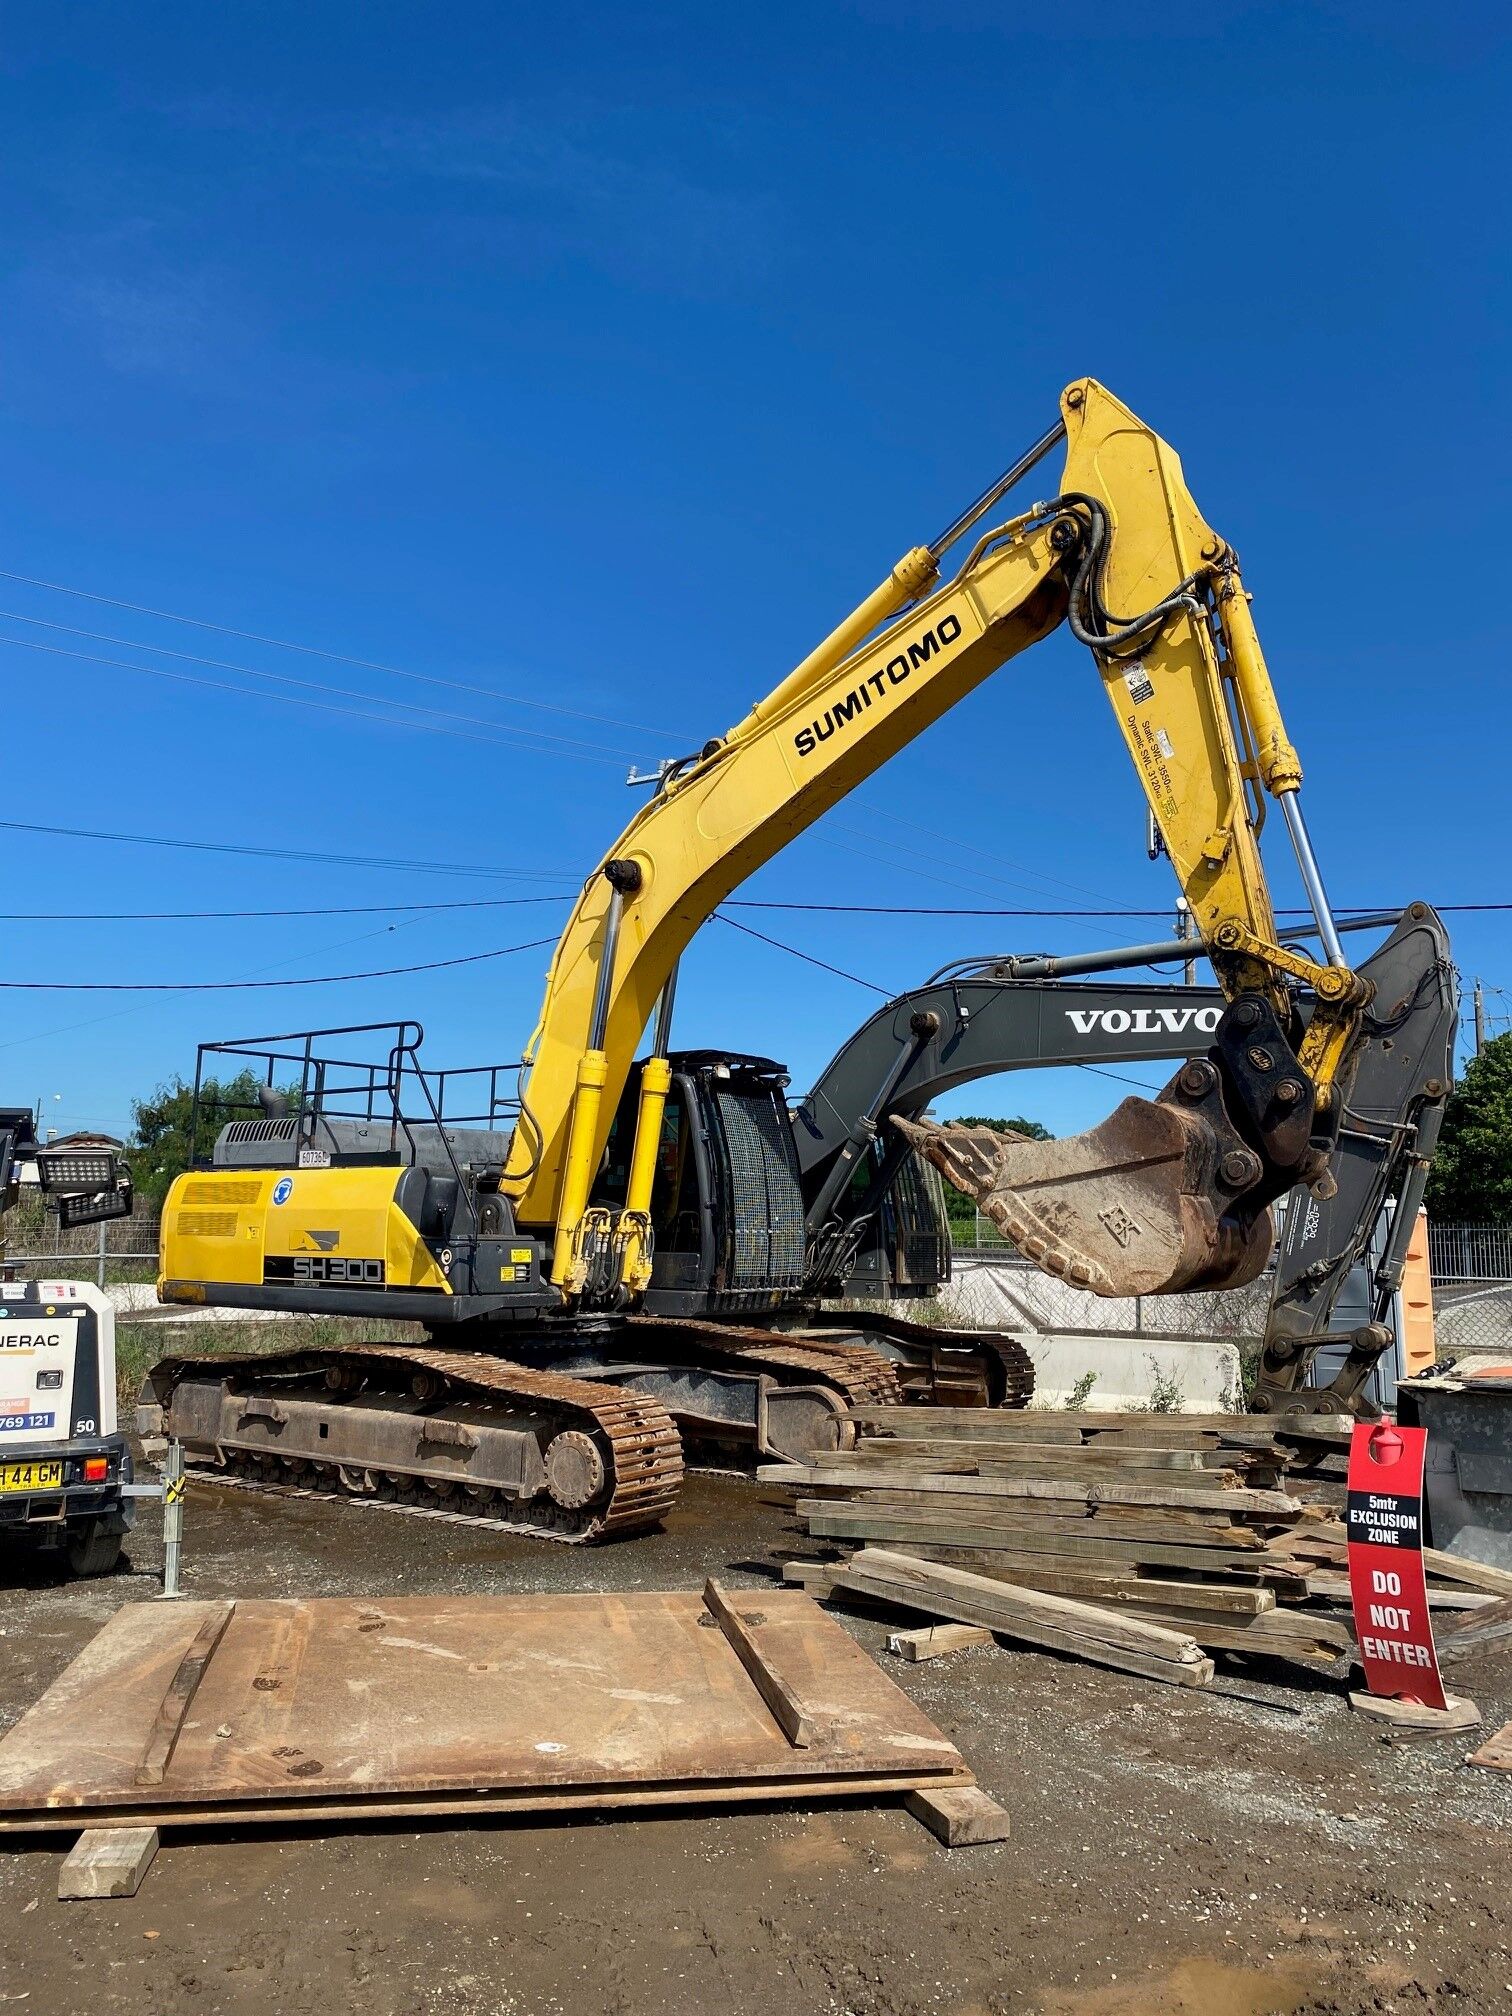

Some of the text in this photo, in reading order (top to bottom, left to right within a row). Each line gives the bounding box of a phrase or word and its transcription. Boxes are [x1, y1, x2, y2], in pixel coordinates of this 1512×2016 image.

[794, 614, 962, 757] SUMITOMO
[1127, 714, 1144, 749] Dynamic
[1140, 749, 1152, 771] SWL:
[1142, 720, 1155, 744] Static
[1150, 743, 1163, 765] SWL:
[1065, 1007, 1224, 1034] VOLVO
[28, 1414, 49, 1427] 121
[76, 1419, 95, 1433] 50
[12, 1466, 32, 1485] 44
[38, 1463, 60, 1483] GM
[1369, 1495, 1398, 1511] 5mtr
[1350, 1510, 1417, 1530] EXCLUSION
[1368, 1528, 1400, 1545] ZONE
[1372, 1570, 1402, 1596] DO
[1369, 1604, 1411, 1632] NOT
[1362, 1636, 1433, 1668] ENTER
